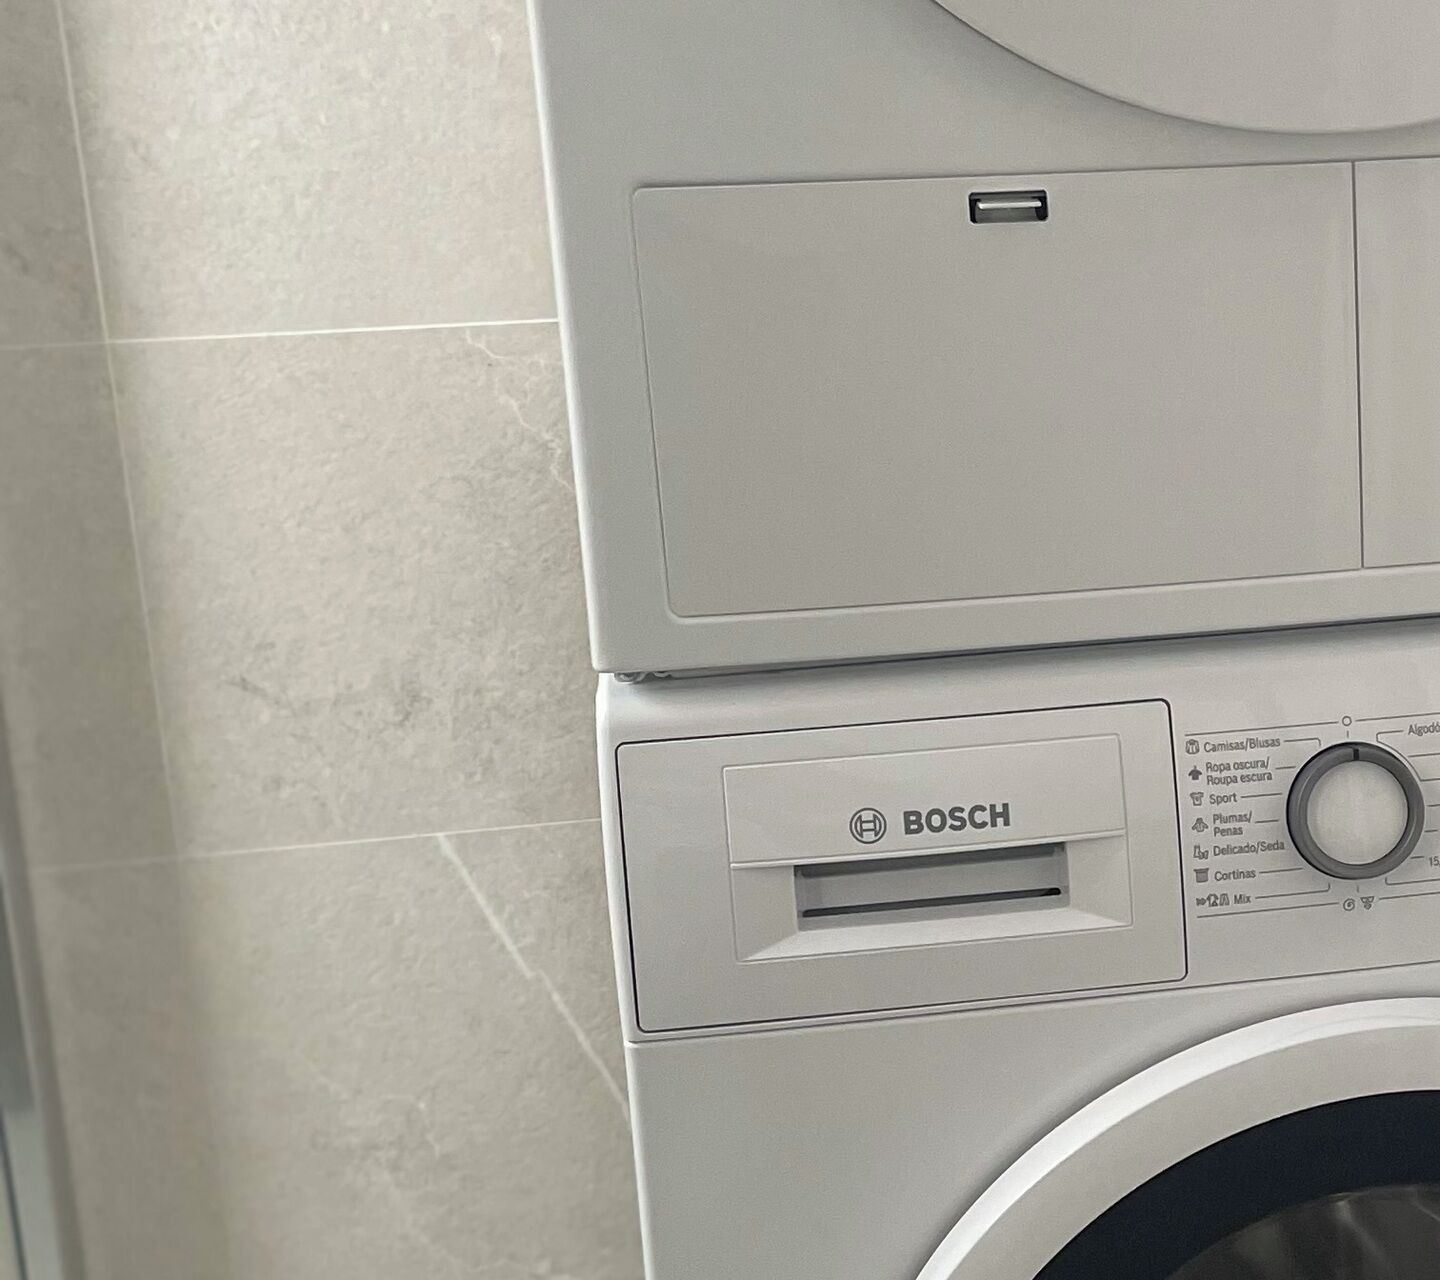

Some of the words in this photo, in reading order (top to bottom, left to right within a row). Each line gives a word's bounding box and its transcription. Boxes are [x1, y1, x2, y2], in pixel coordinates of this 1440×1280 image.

[1203, 737, 1280, 753] Camisas/Blusas
[1206, 762, 1231, 774] Ropa
[1233, 756, 1270, 770] oscura/
[1206, 774, 1238, 786] Roupa
[1240, 772, 1273, 783] escura
[1209, 793, 1237, 806] Sport
[903, 802, 1010, 835] BOSCH
[1213, 810, 1252, 824] Plumas/
[1213, 826, 1243, 837] Penas
[1213, 840, 1285, 856] Delicado/Seda
[1214, 869, 1256, 881] Cortinas
[1233, 893, 1252, 904] Mix
